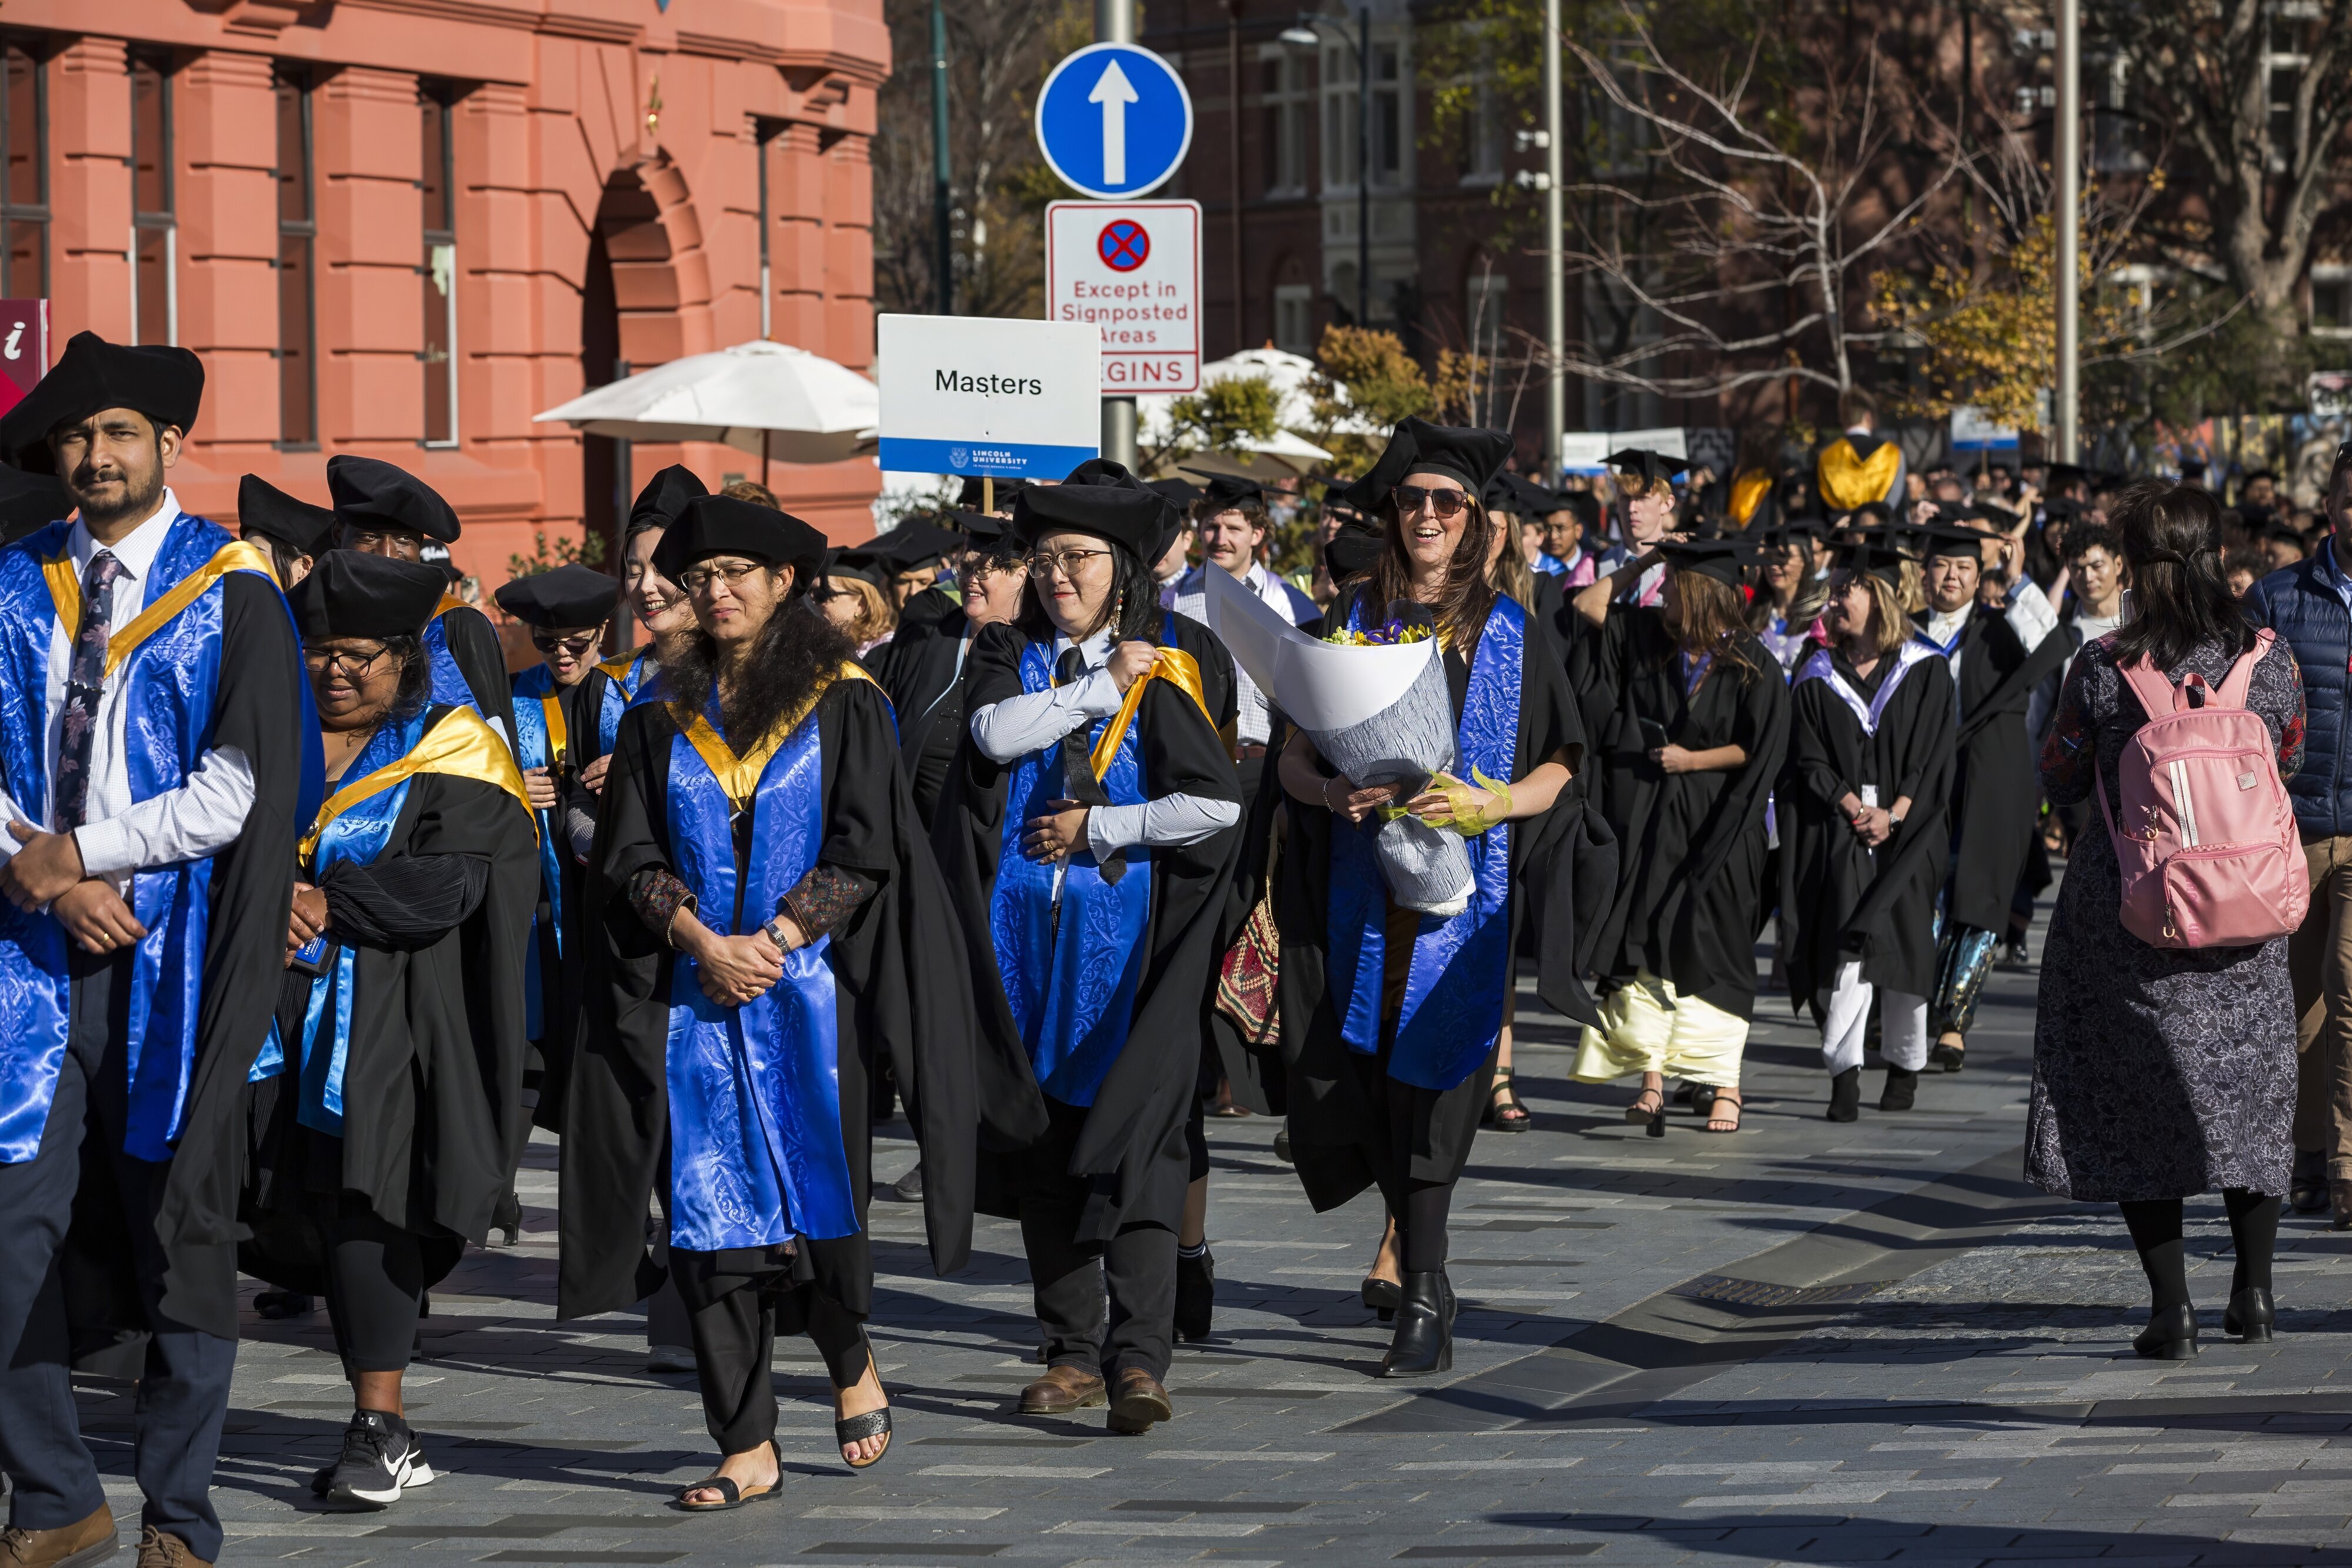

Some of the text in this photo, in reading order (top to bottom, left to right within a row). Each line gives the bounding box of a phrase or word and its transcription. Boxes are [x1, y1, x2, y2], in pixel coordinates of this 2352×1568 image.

[1074, 281, 1176, 301] Except in
[1062, 303, 1187, 323] Signposted
[1101, 361, 1183, 382] GINS
[936, 369, 1042, 395] Masters
[972, 456, 1027, 465] UNIVERSITY
